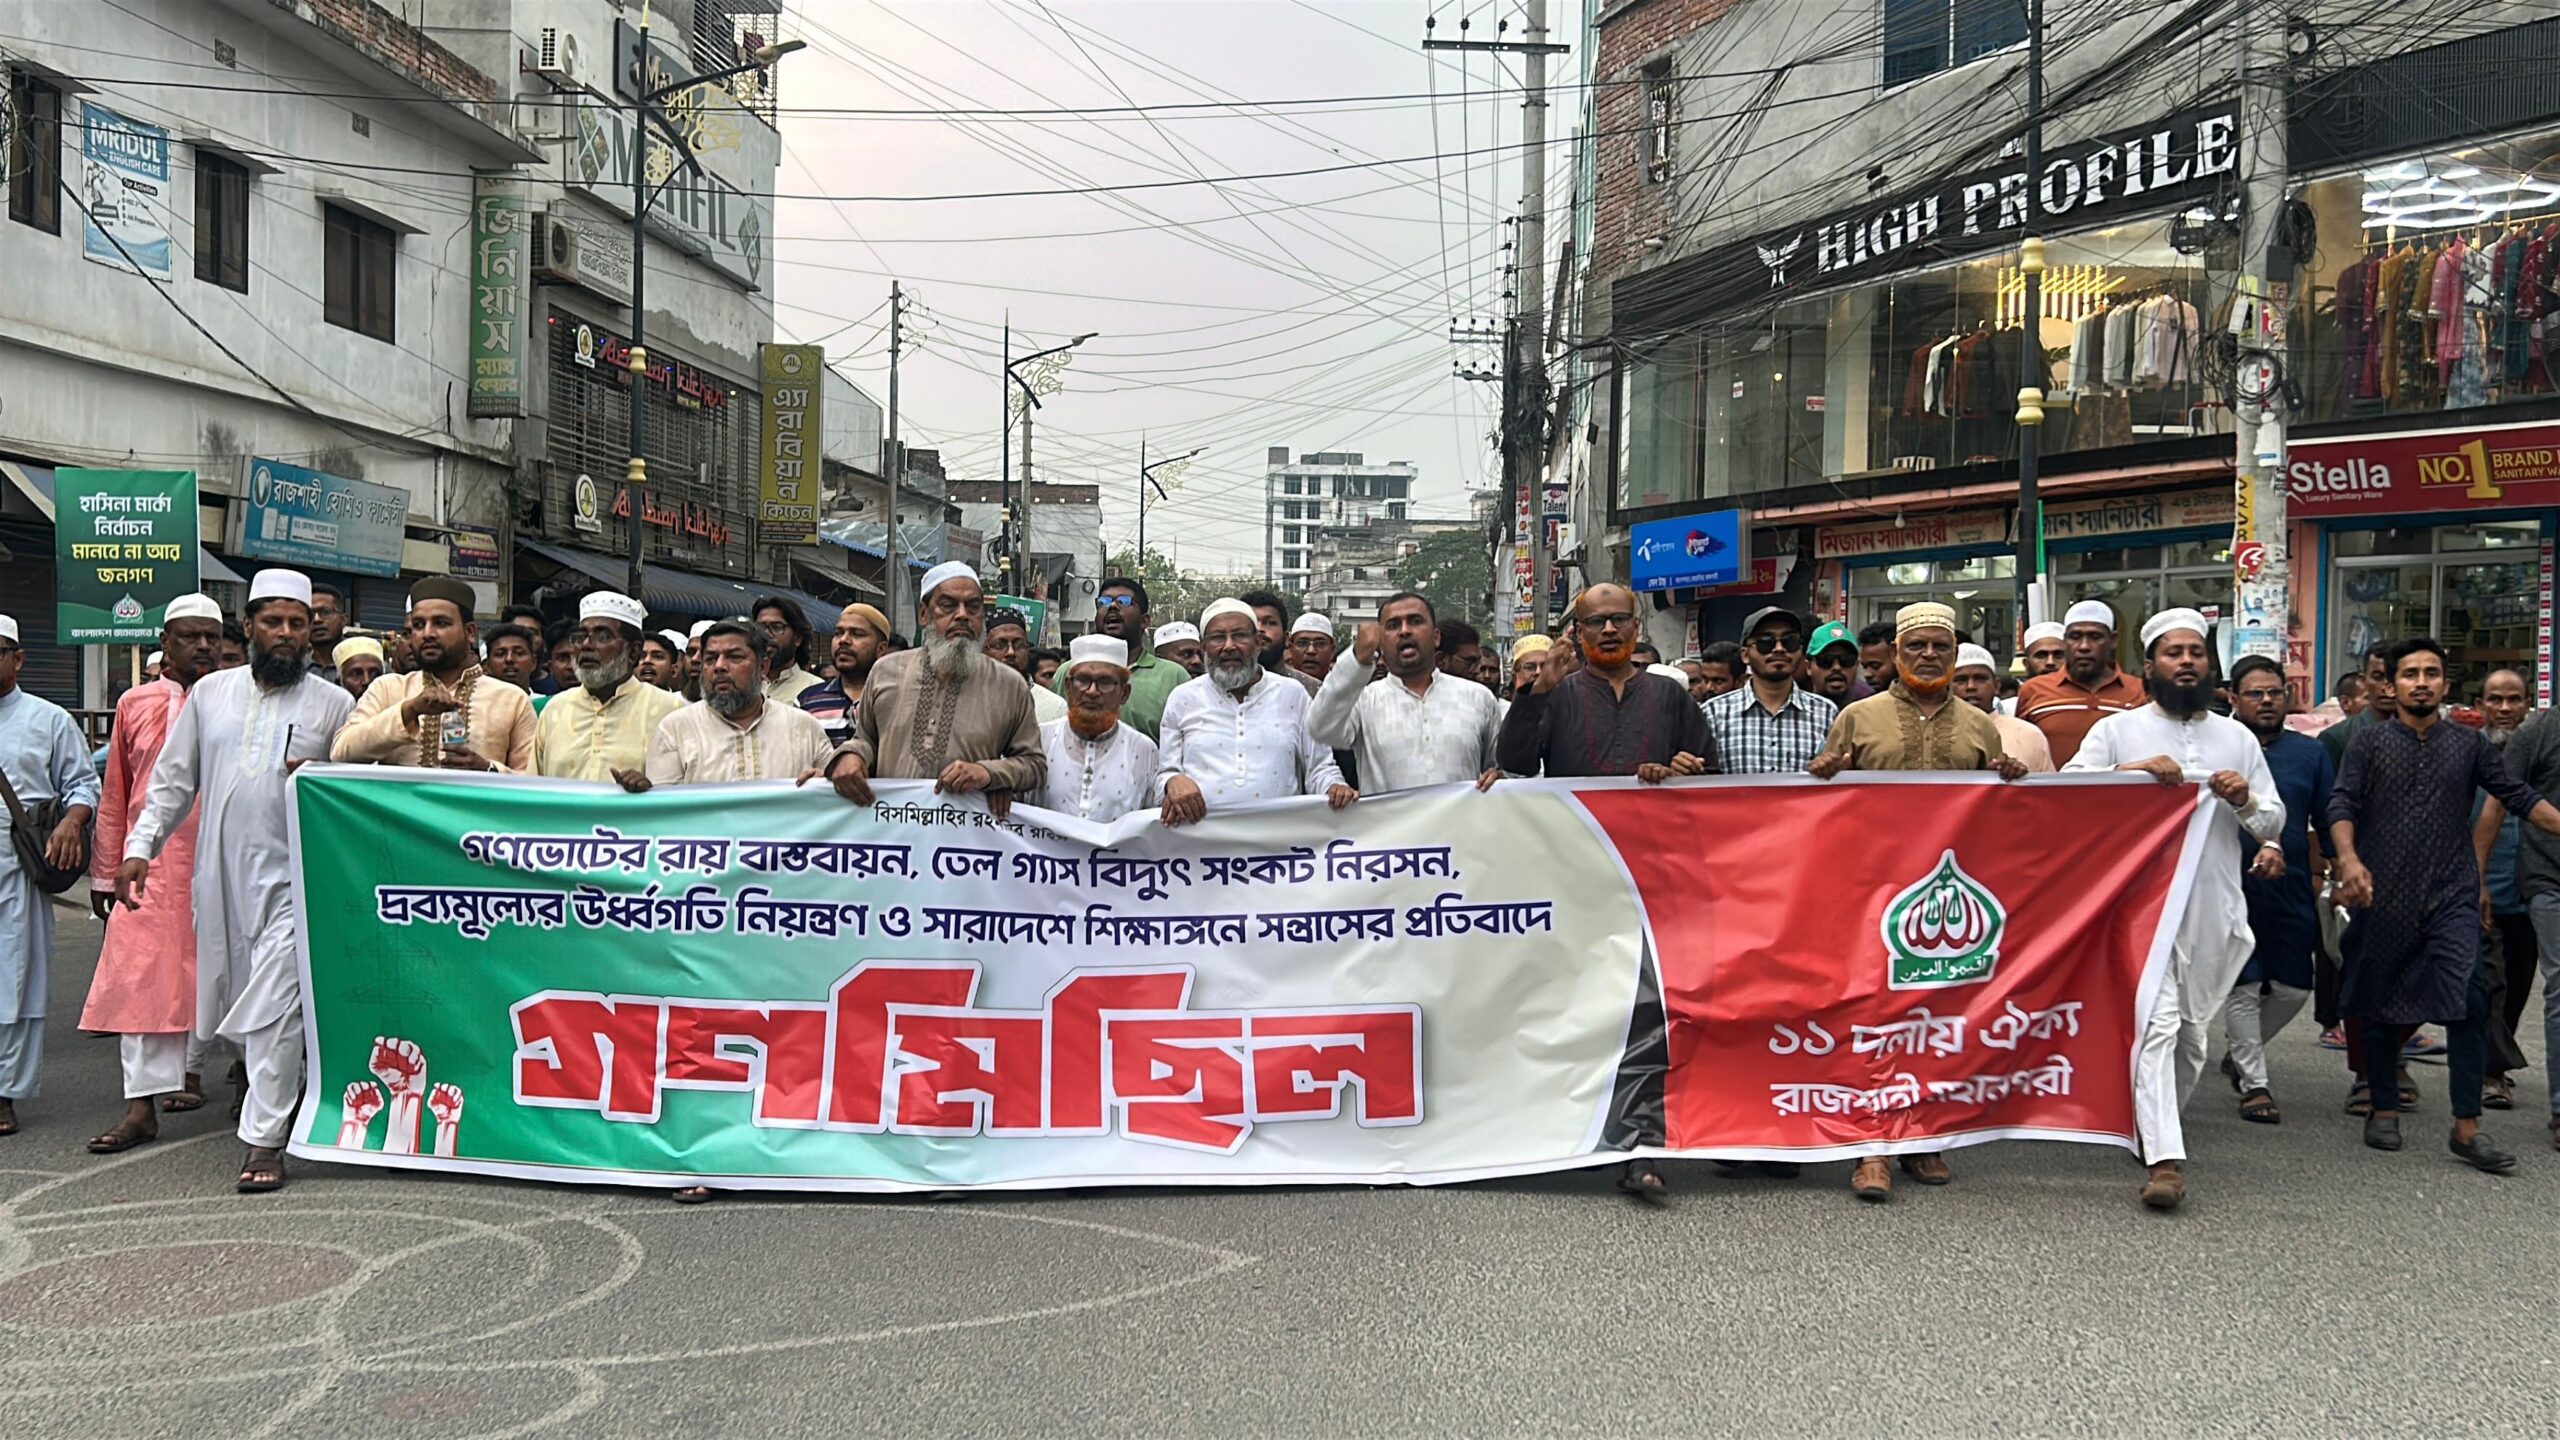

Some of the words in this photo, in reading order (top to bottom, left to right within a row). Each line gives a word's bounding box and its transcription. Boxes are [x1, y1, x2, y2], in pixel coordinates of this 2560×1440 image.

[90, 117, 162, 163] MRIDUL
[109, 151, 140, 171] ENGLISH
[141, 162, 162, 177] CARE
[1817, 195, 1939, 275] HIGH
[1961, 113, 2238, 237] PROFILE
[478, 197, 520, 354] জিনিয়াস
[2492, 450, 2553, 469] BRAND
[2494, 467, 2544, 480] SANITARY
[2289, 458, 2392, 494] Stella
[79, 493, 131, 513] হাসিনা
[135, 491, 172, 513] মার্কা
[273, 478, 323, 512] রাজশাহী
[325, 488, 363, 519] হোমিও
[763, 499, 814, 519] কিচেন
[1543, 500, 1567, 512] Talent
[2305, 492, 2331, 504] Luxury
[2331, 491, 2362, 503] Sanitary
[2363, 489, 2383, 499] Ware
[94, 516, 154, 537] নির্বাচন
[2075, 496, 2163, 534] স্যানিটারী
[71, 543, 120, 560] মানবে
[124, 543, 142, 560] না
[146, 543, 181, 562] আর
[1819, 527, 1875, 555] মিজান
[96, 568, 153, 584] জনগণ
[71, 628, 112, 638] বাংলাদেশ
[874, 800, 967, 829] বিসমিল্লাহির
[462, 828, 650, 871] গণভোটের
[658, 840, 731, 875] রায়
[739, 841, 919, 881] বাস্তবায়ন,
[932, 846, 1003, 881] তেল
[1012, 852, 1080, 887] গ্যাস
[1088, 845, 1192, 901] বিদ্যুৎ
[1199, 846, 1316, 885] সংকট
[1325, 839, 1461, 883] নিরসন,
[378, 888, 565, 936] দ্রব্যমূল্যের
[736, 888, 868, 938] নিয়ন্ত্রণ
[879, 906, 911, 938] ও
[922, 906, 1077, 946] সারাদেশে
[1083, 902, 1248, 946] শিক্ষাঙ্গনে
[1256, 908, 1395, 945] সন্ত্রাসের
[1405, 892, 1553, 938] প্রতিবাদে
[1768, 1020, 1835, 1055] ১১
[1850, 1006, 1968, 1060] দলীয়
[1978, 1000, 2083, 1051] ঐক্য
[514, 963, 1422, 1153] গণমিছিল
